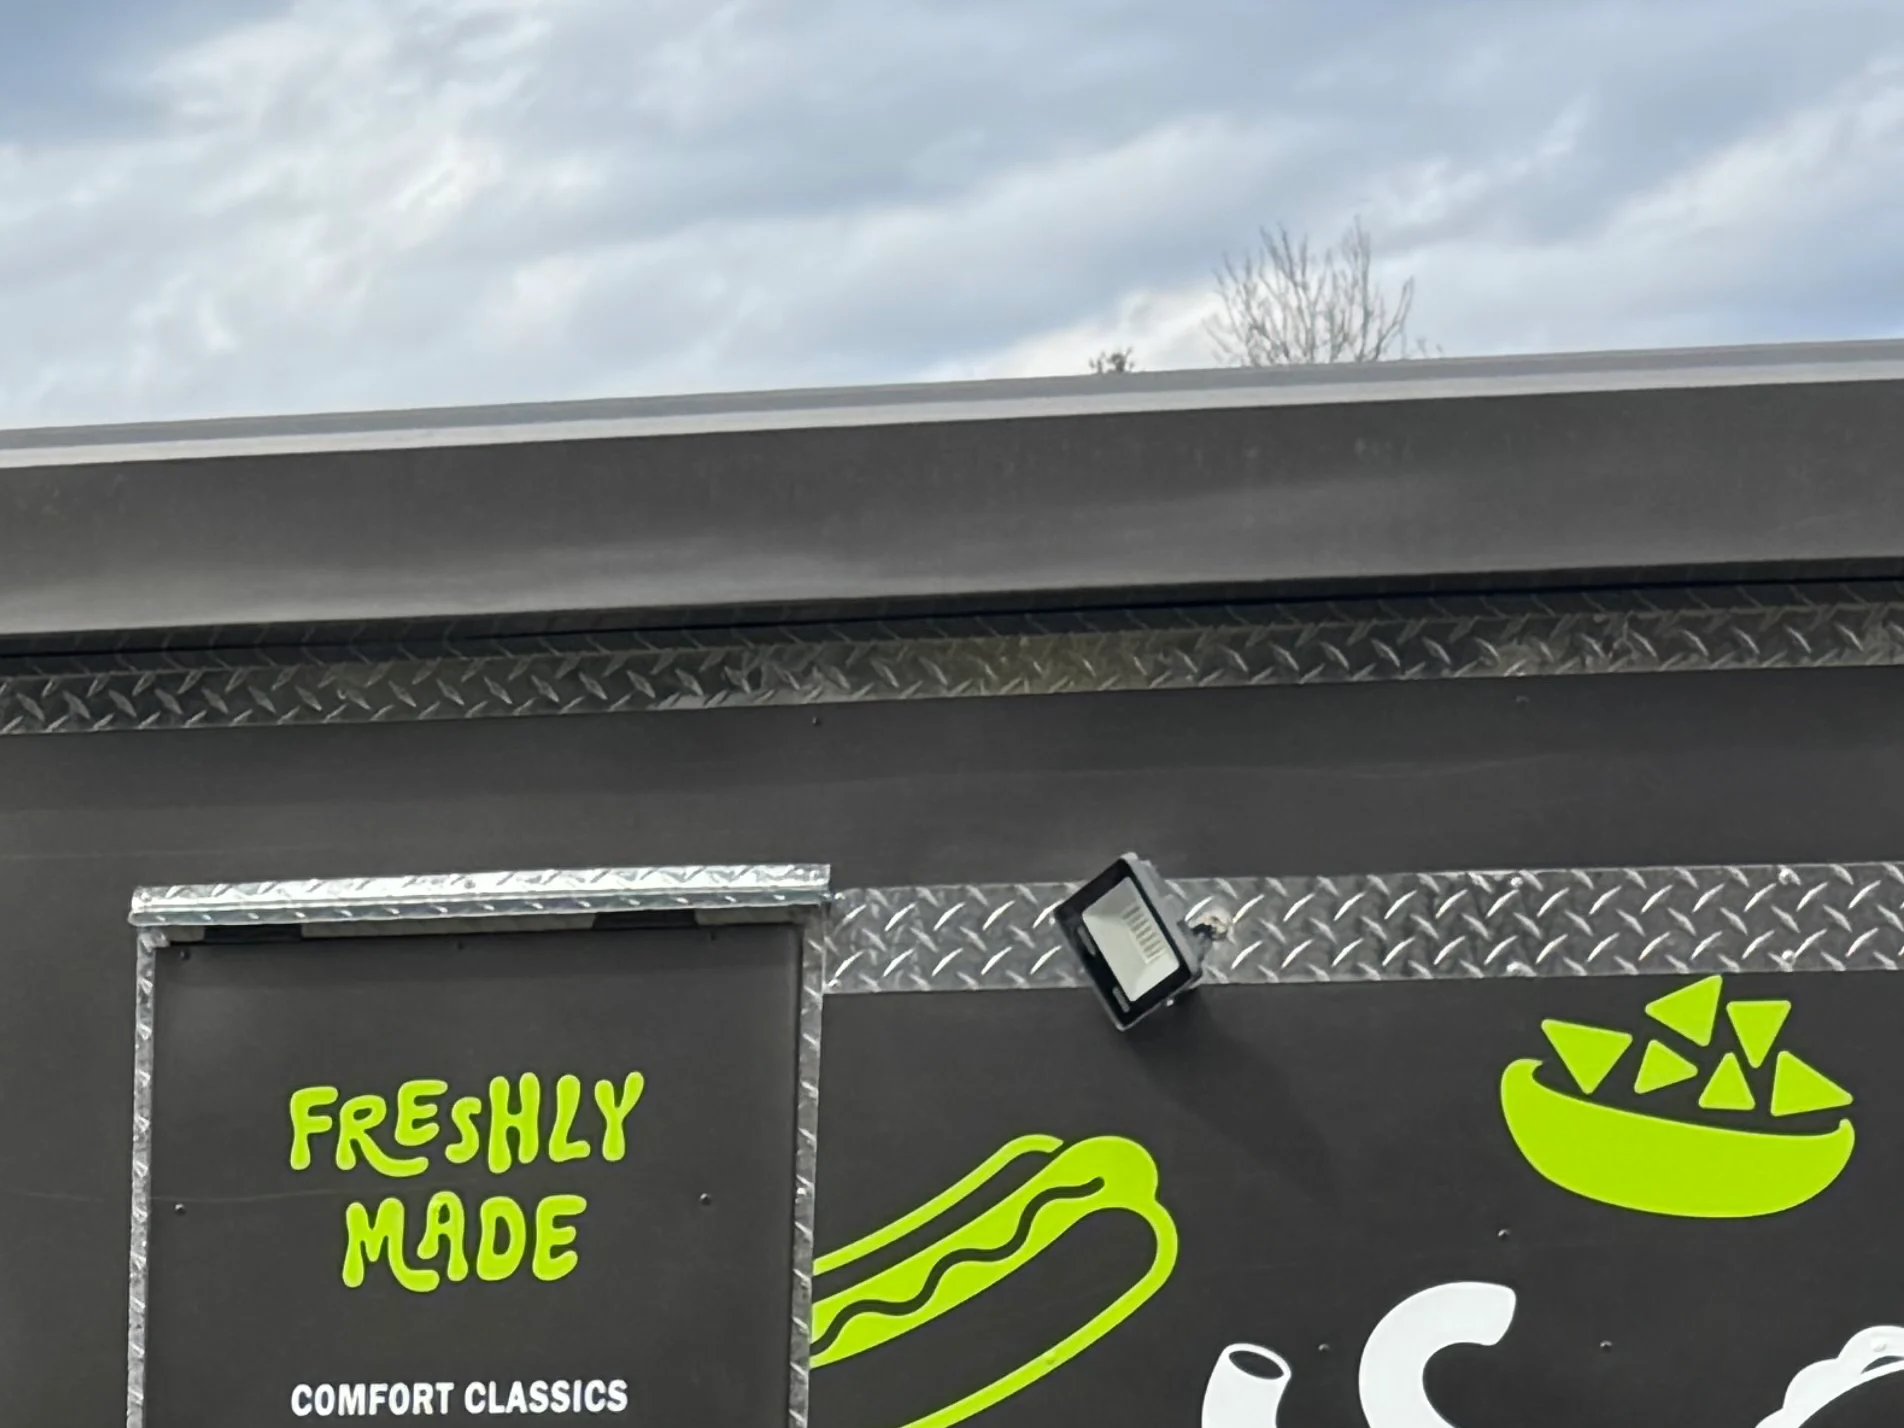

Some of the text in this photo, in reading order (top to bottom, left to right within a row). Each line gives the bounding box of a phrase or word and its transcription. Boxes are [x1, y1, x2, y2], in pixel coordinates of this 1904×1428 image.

[291, 1073, 644, 1177] FRESHLY
[344, 1193, 587, 1292] MADE
[292, 1380, 627, 1416] COMFORT CLASSICS
